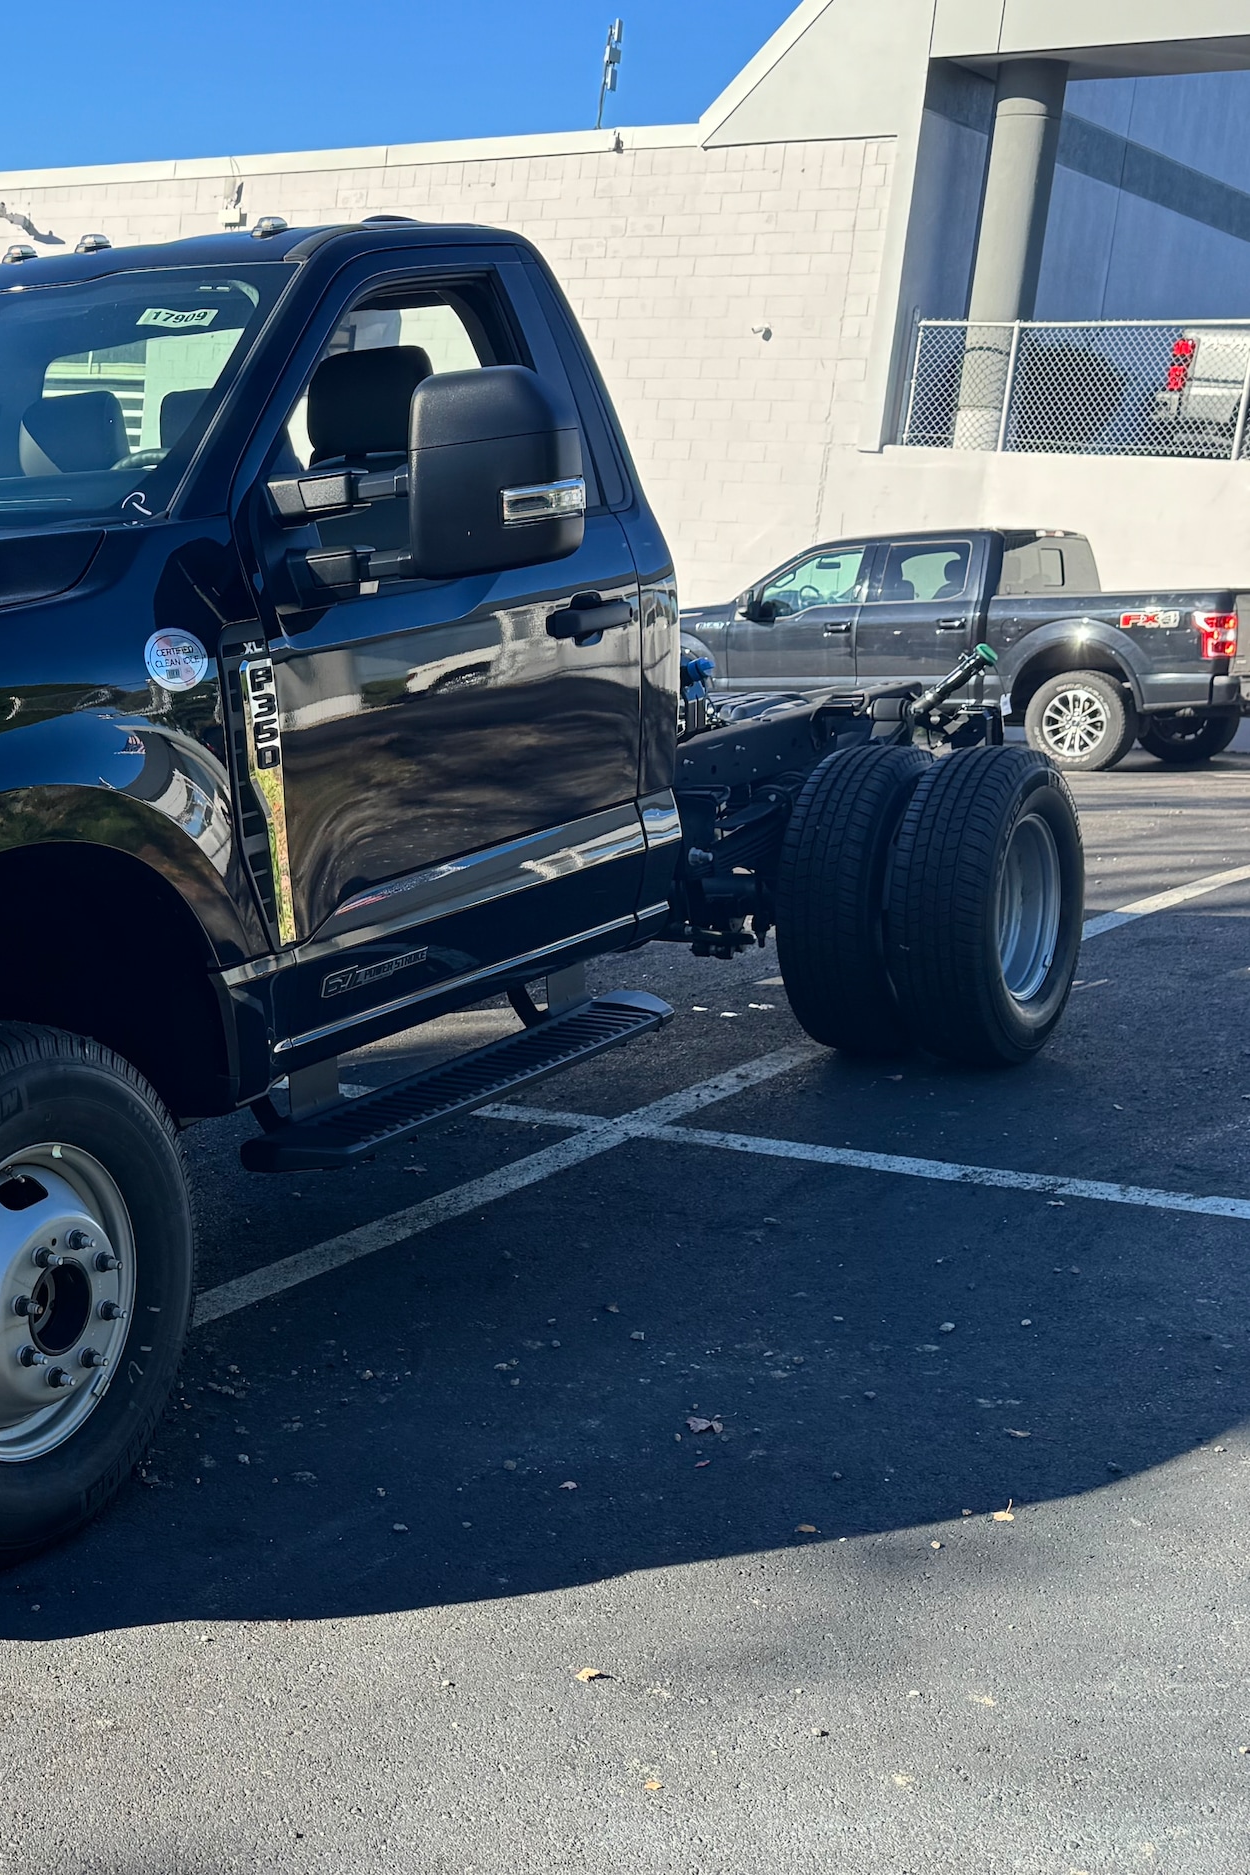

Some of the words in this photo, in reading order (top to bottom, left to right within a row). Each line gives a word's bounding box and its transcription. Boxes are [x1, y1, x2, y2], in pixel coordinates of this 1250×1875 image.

[153, 311, 208, 323] 17909
[156, 645, 194, 657] CERTIFIED
[243, 641, 263, 654] XL
[155, 658, 181, 668] CLEAN
